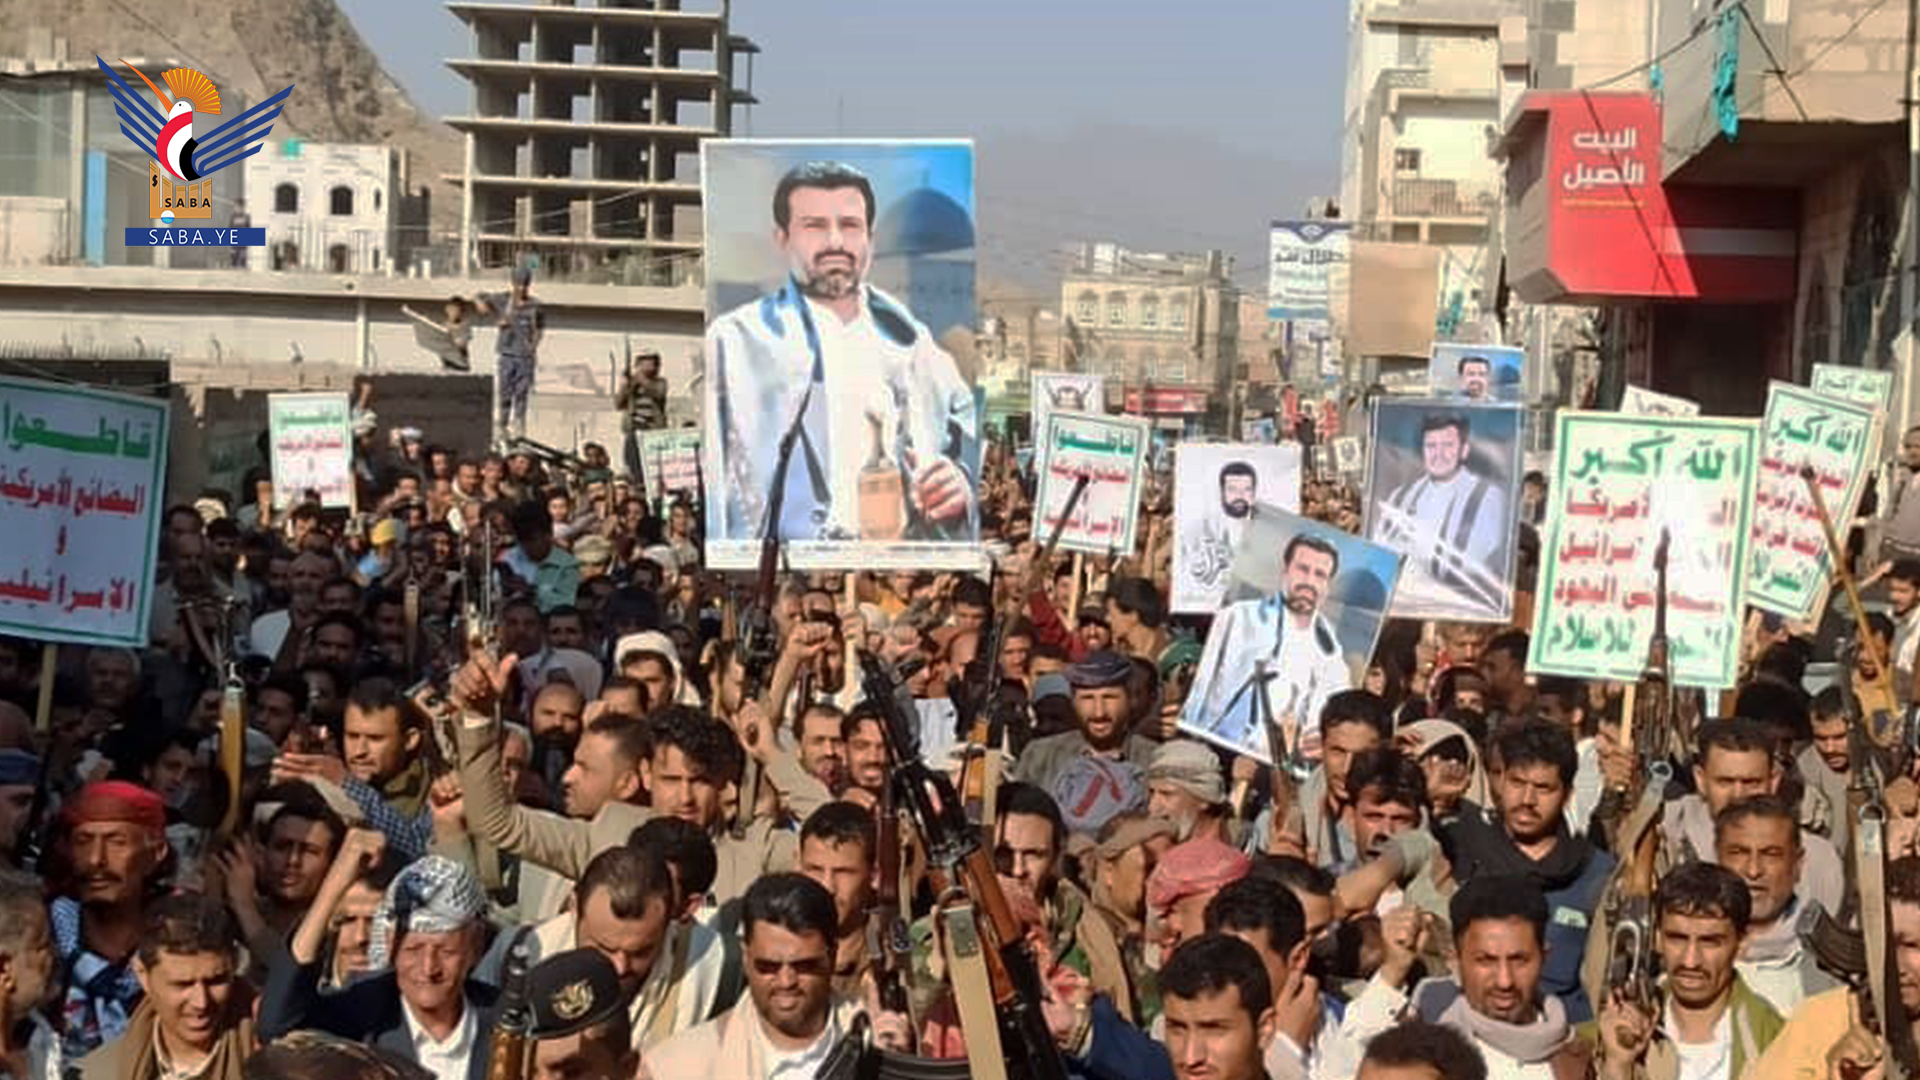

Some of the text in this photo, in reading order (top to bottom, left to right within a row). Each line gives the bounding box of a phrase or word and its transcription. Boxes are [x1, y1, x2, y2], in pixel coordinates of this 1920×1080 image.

[1573, 127, 1637, 155] البيت
[3, 402, 151, 459] قاطعوا
[1569, 428, 1676, 485] أكبر
[1681, 440, 1743, 480] الله
